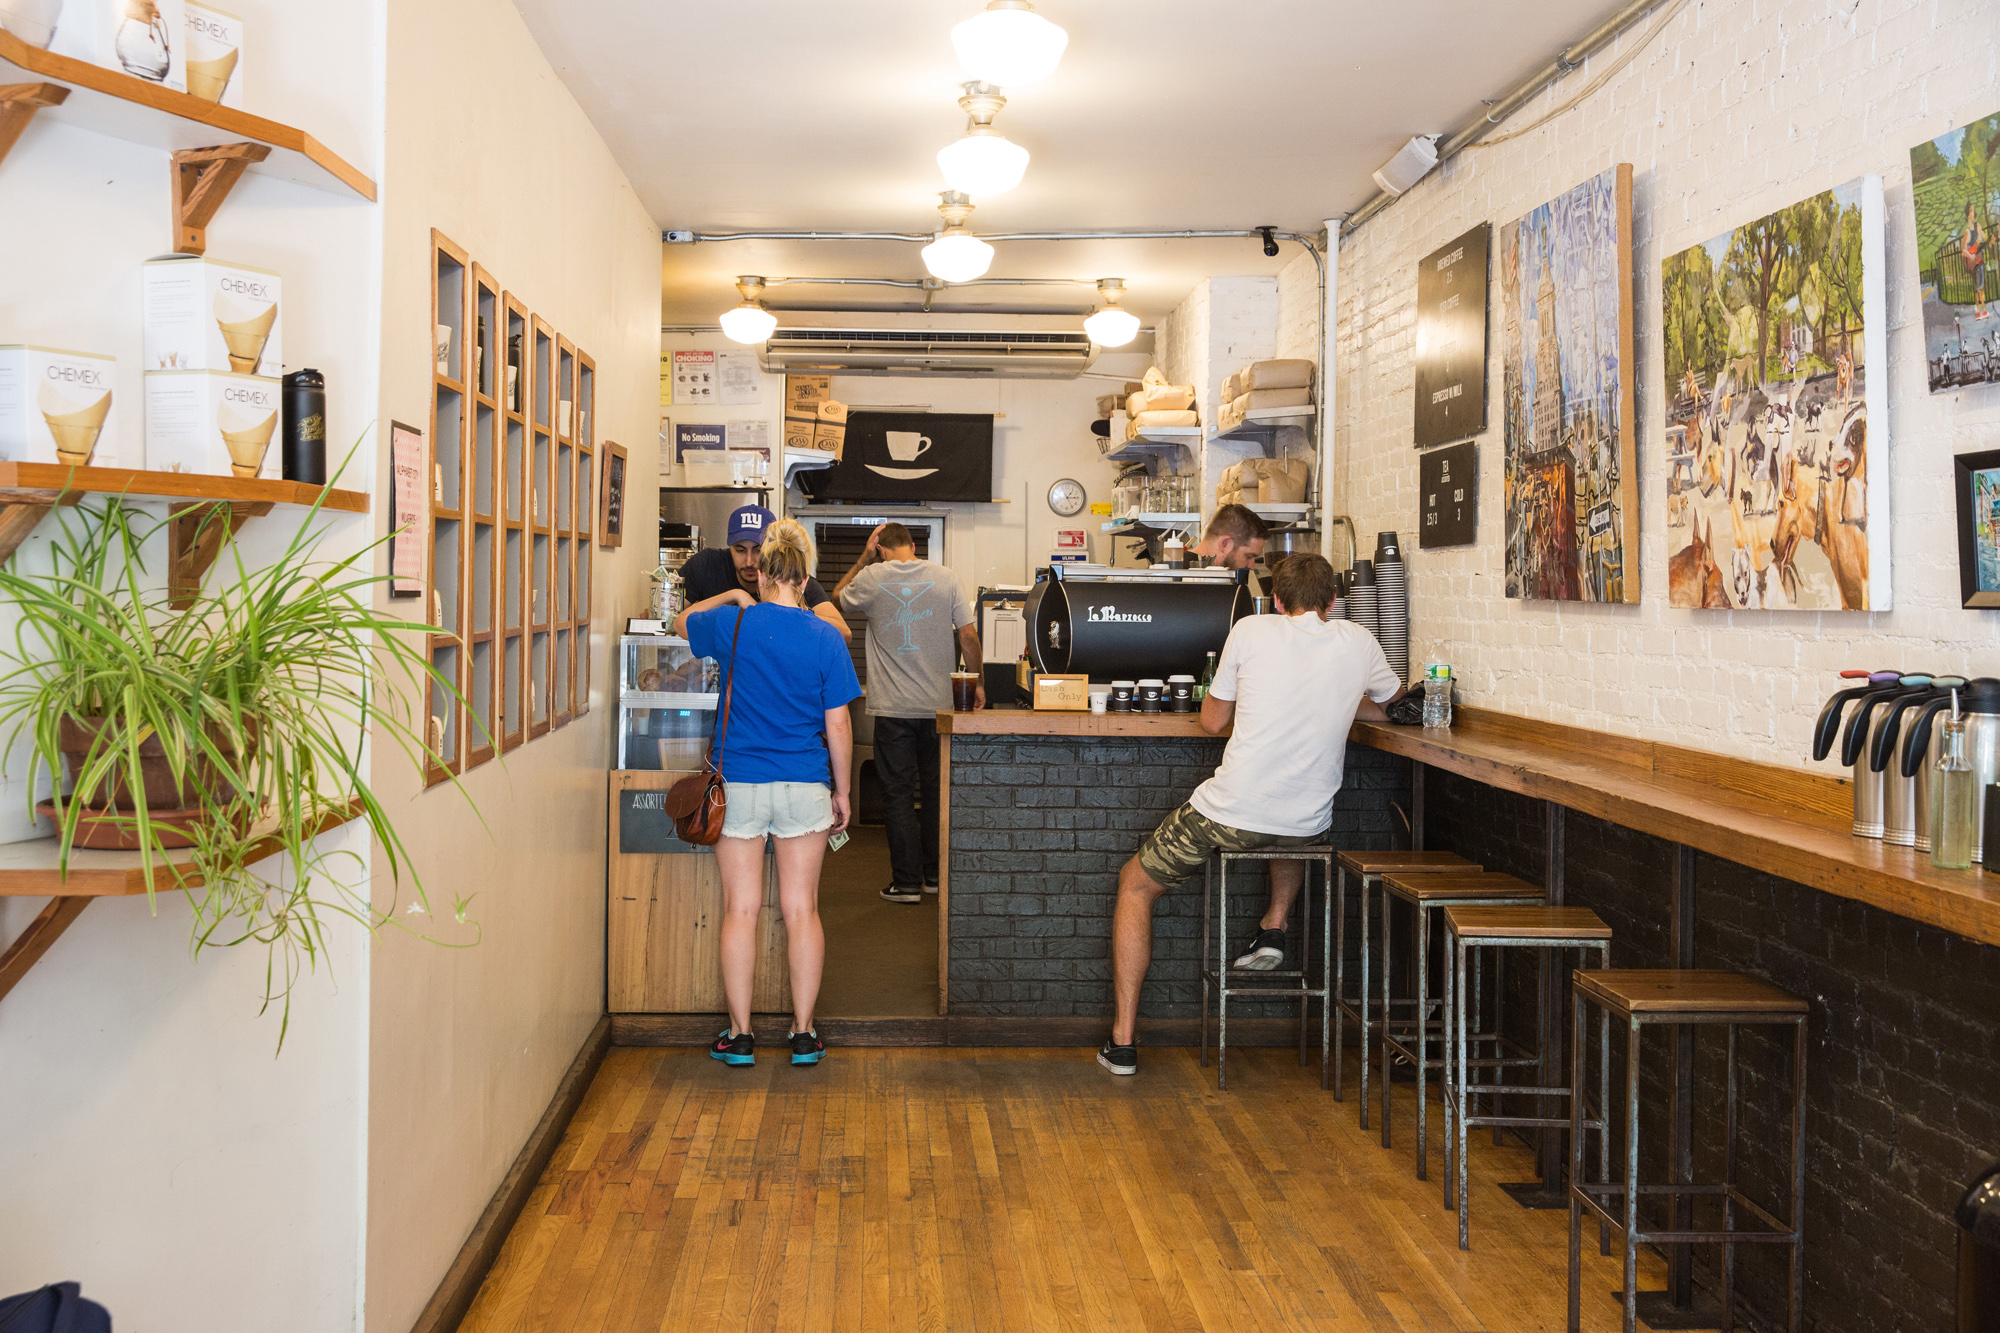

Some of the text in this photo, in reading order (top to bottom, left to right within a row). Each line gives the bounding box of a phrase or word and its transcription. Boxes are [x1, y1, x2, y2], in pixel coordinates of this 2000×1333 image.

[1437, 246, 1463, 271] BREWED COFFEE
[220, 277, 267, 297] CHEMEX
[1447, 293, 1459, 310] COFFEE
[47, 365, 102, 385] CHEMEX
[224, 387, 269, 406] CHEMEX
[1432, 388, 1449, 405] ESPRESSO
[681, 433, 720, 443] No Smoking
[1454, 488, 1464, 503] COLD
[740, 512, 762, 529] ny
[1058, 692, 1082, 702] Only
